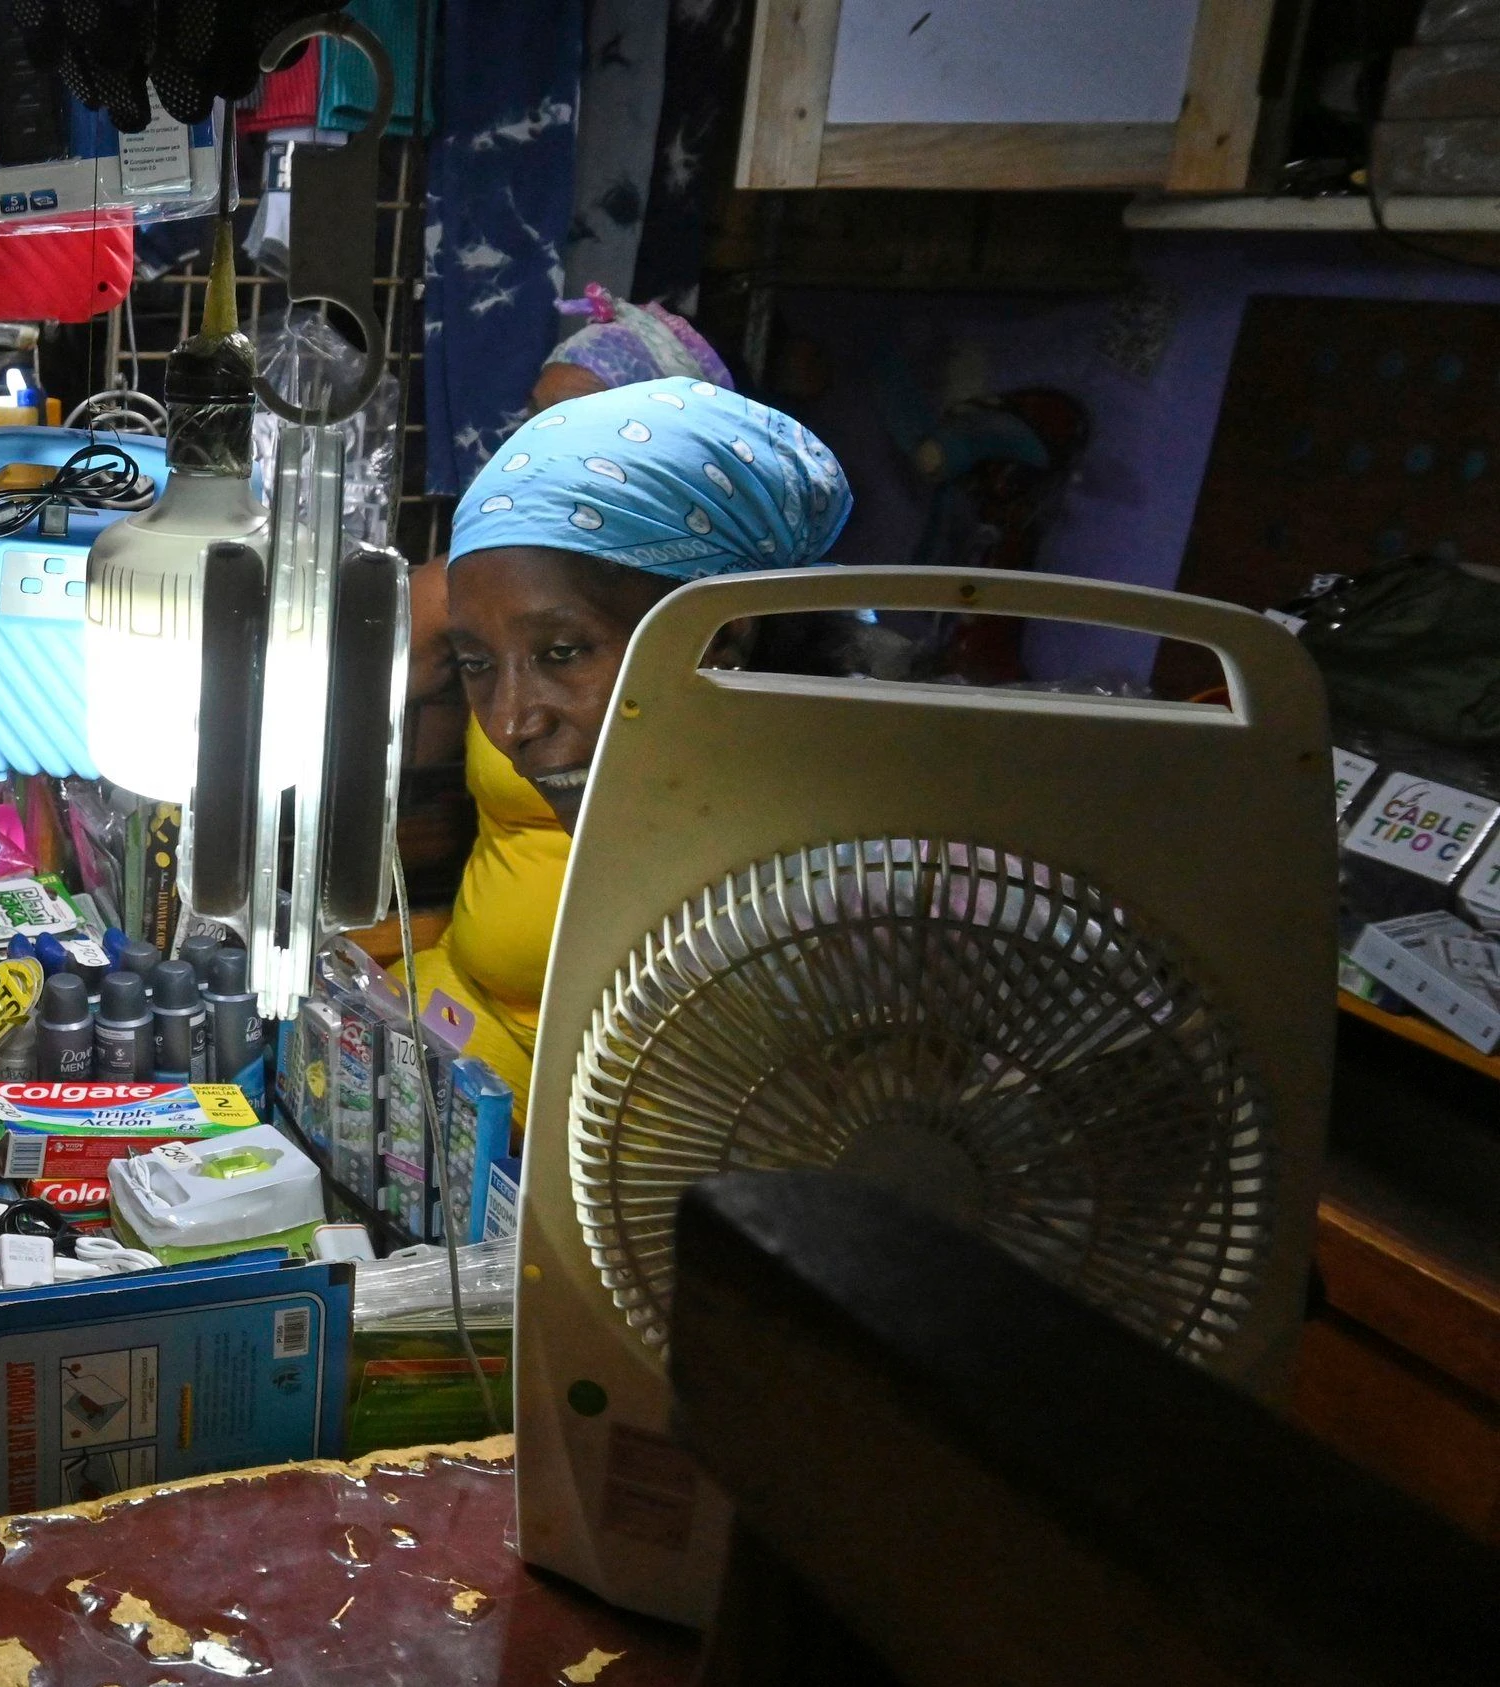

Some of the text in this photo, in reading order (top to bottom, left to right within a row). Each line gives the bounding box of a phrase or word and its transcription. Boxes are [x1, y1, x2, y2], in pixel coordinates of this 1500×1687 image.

[10, 195, 19, 206] 5
[1382, 798, 1477, 847] CABLE
[1370, 816, 1434, 852] TIPO
[1437, 847, 1462, 866] C
[60, 1061, 84, 1073] MEN
[215, 1097, 233, 1108] 2
[92, 1109, 156, 1120] Triple
[158, 1144, 194, 1164] 2500
[40, 1182, 109, 1206] Colg
[6, 1361, 36, 1426] PRODUCT
